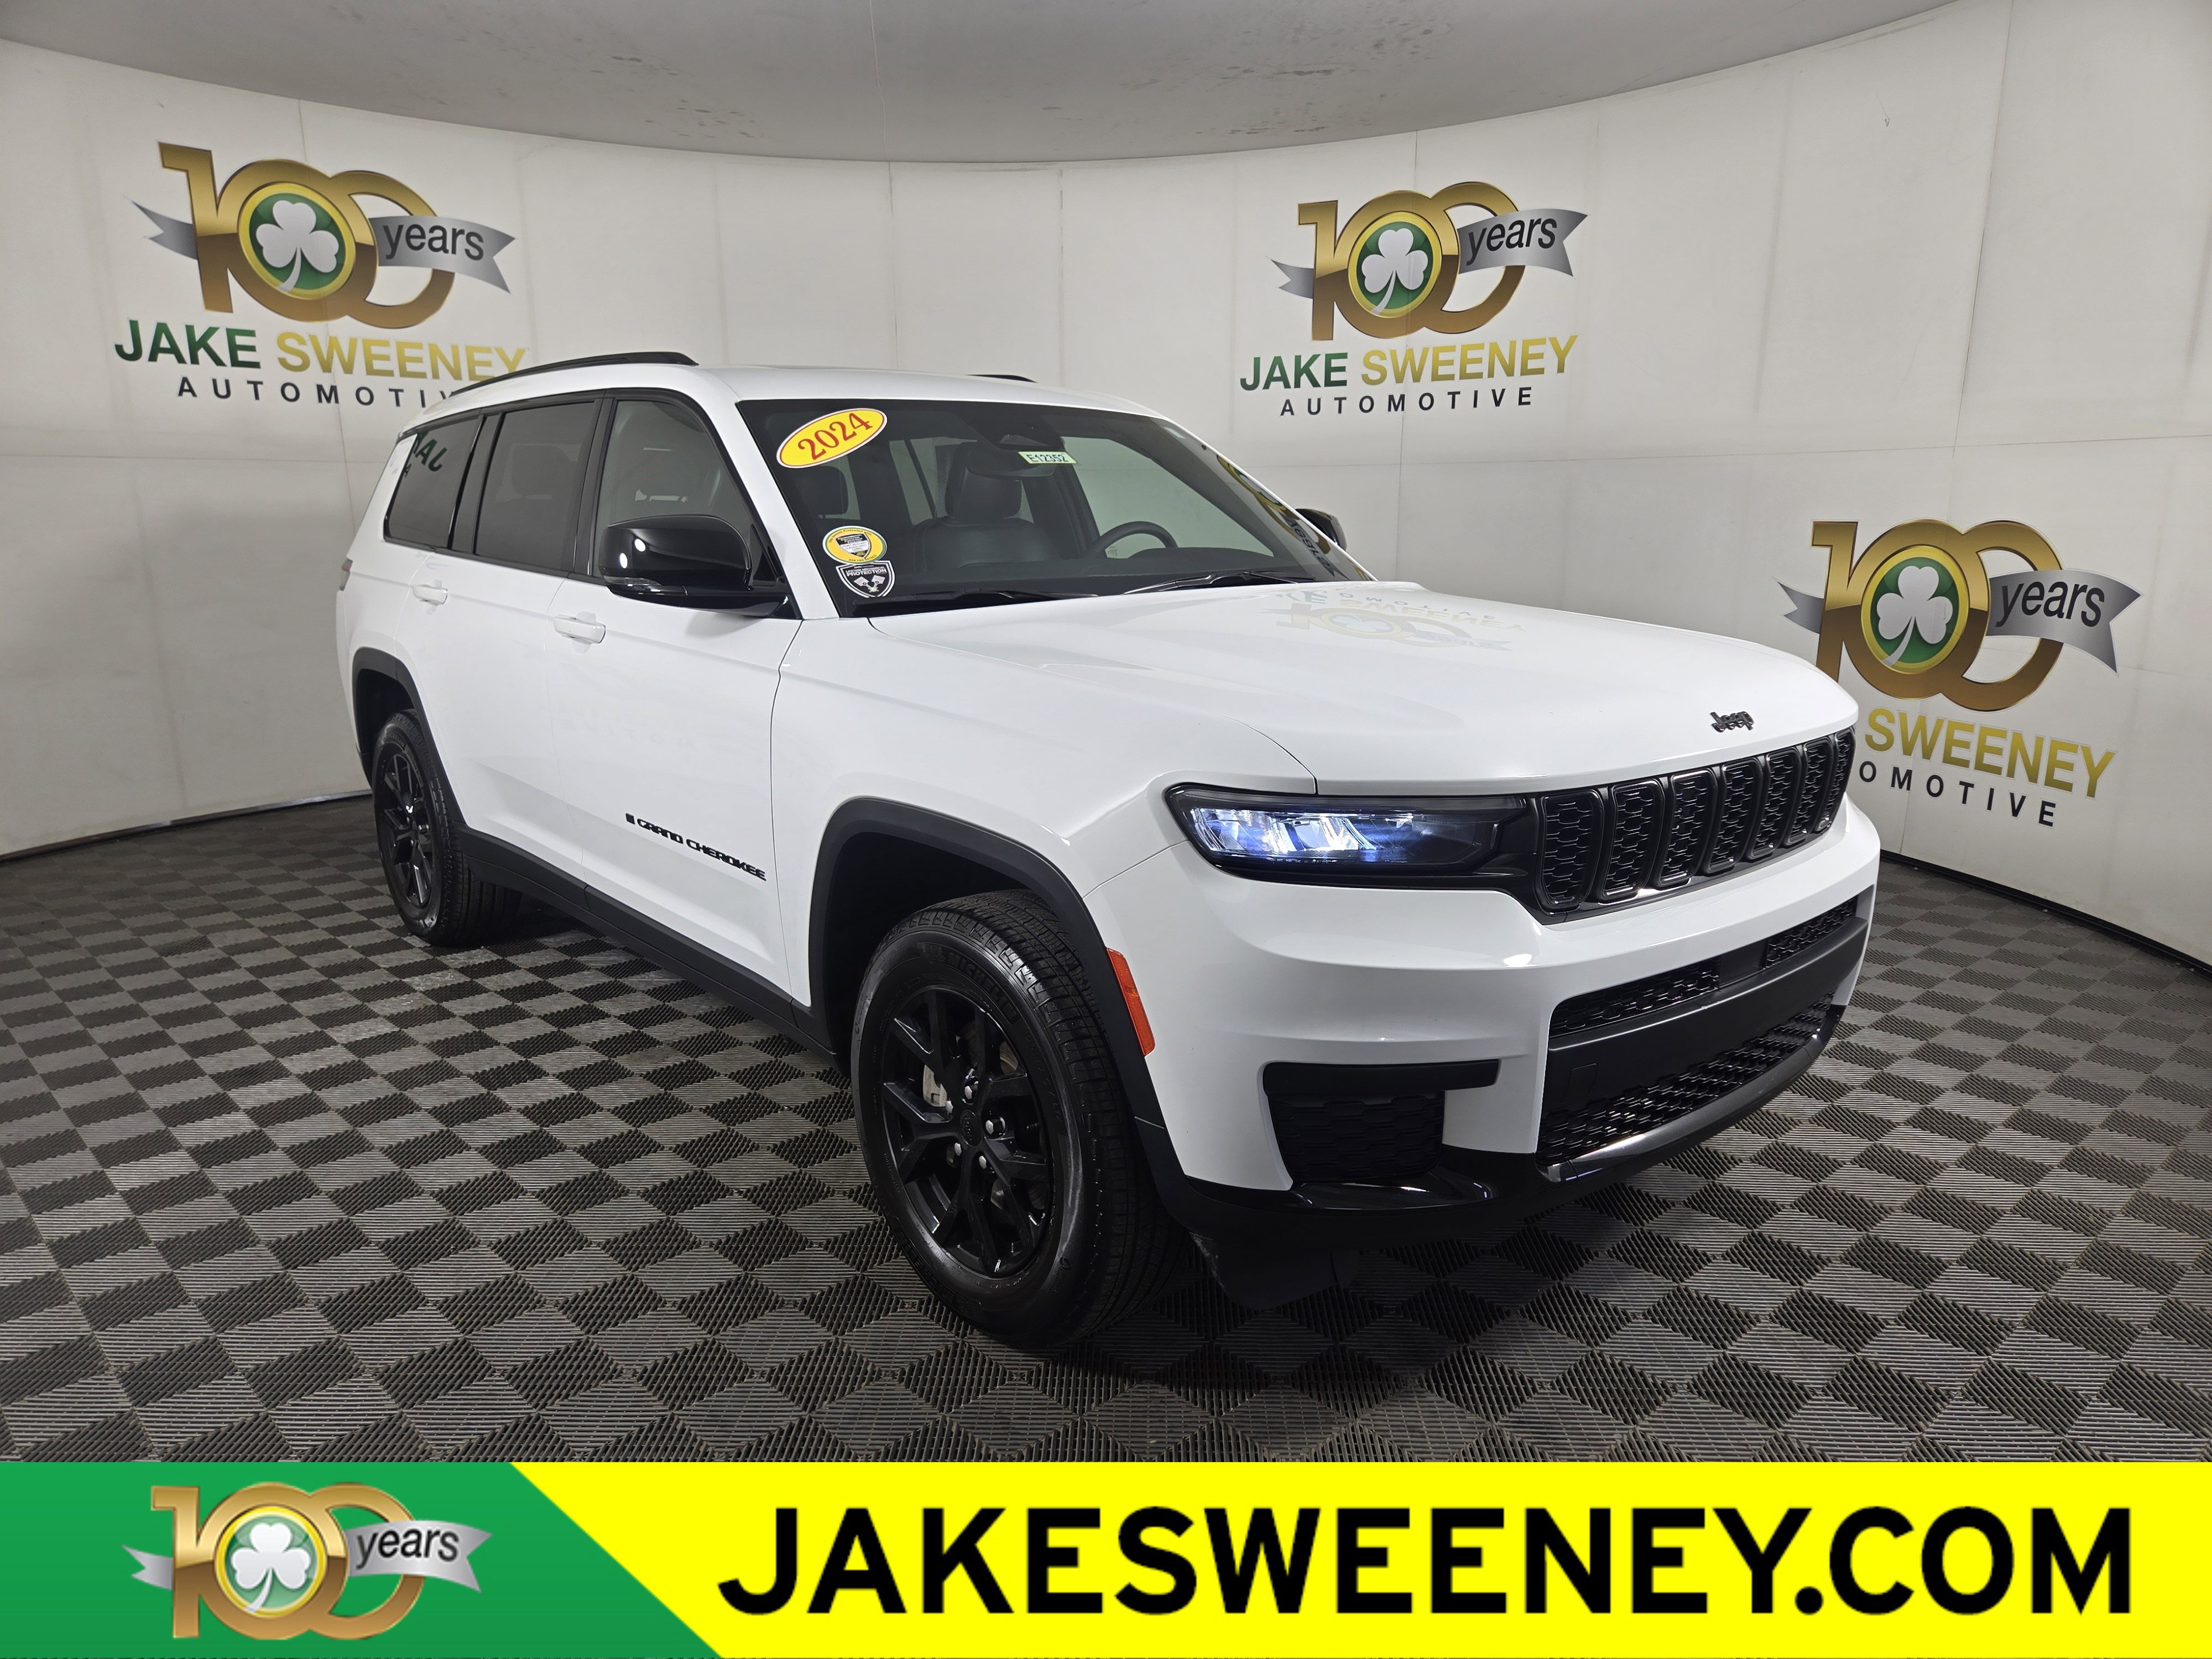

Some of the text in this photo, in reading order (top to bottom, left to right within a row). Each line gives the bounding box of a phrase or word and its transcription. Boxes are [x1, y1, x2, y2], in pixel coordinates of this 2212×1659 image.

[158, 141, 484, 328] 100 years
[1297, 181, 1558, 341] 100 years
[114, 319, 526, 382] JAKE SWEENEY
[1240, 335, 1579, 391] JAKE SWEENEY
[178, 377, 446, 408] AUTOMOTI
[1280, 387, 1532, 416] AUTOMOTIVE
[797, 413, 873, 460] 2024
[1025, 454, 1069, 462] E12352
[846, 568, 887, 577] PROTECTION
[1811, 519, 2106, 712] 100 years
[1710, 711, 1755, 733] Jeep
[1865, 708, 2116, 799] SWEENEY
[1859, 760, 2057, 827] OMOTIVE
[637, 818, 766, 881] GRAND CHEROKEE
[946, 951, 1019, 1022] MICHELIN
